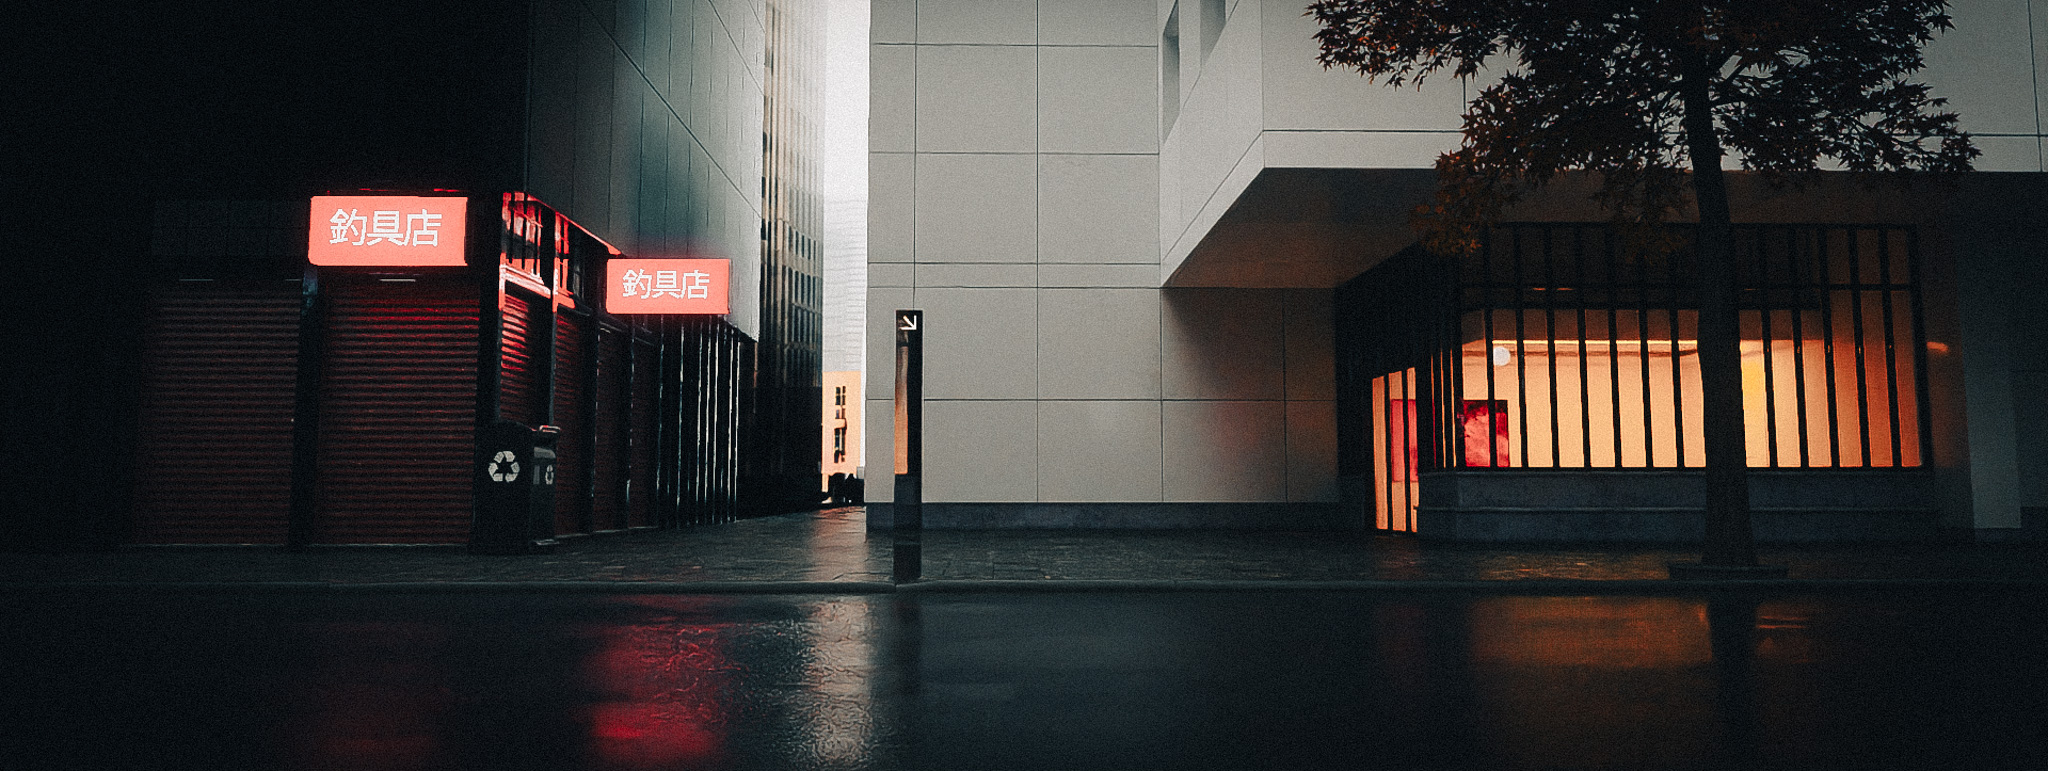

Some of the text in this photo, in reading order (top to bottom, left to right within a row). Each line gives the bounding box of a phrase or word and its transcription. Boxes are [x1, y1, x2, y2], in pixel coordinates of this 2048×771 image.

[329, 208, 443, 247] 釣具店
[622, 268, 710, 300] 釣具店
